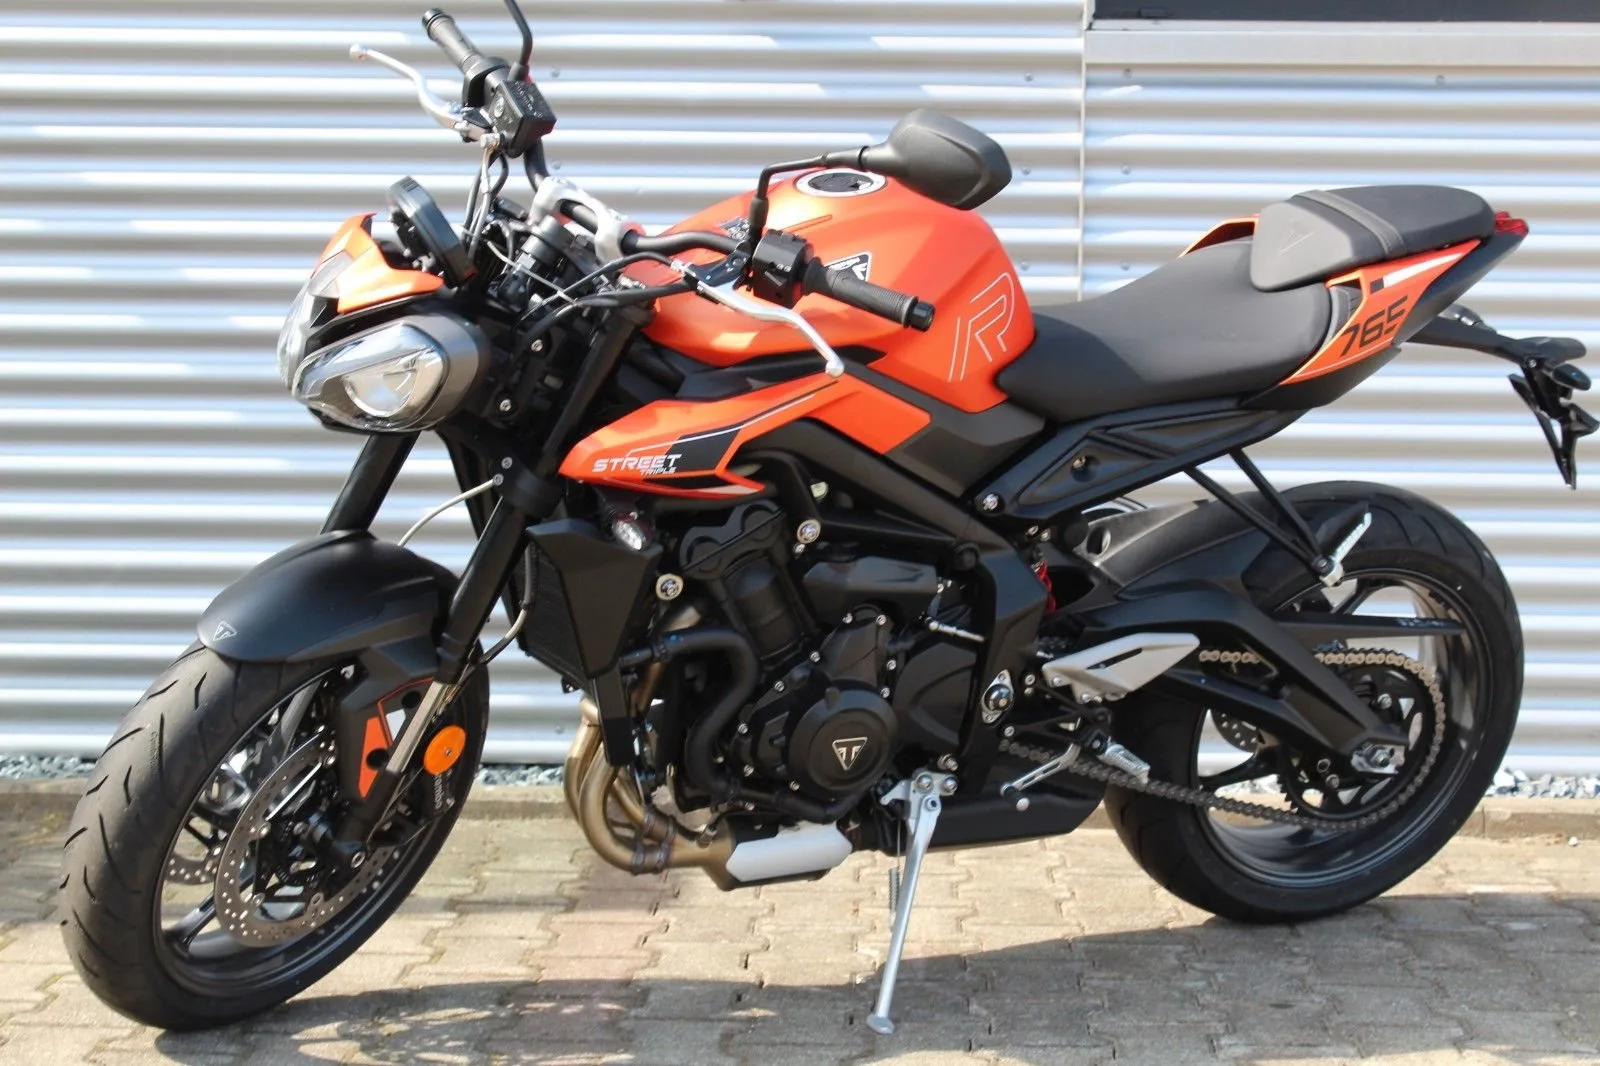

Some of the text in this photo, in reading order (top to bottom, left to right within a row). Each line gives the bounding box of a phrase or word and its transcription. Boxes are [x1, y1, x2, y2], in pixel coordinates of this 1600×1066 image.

[1341, 295, 1408, 357] 765
[592, 454, 682, 472] STREET
[640, 466, 677, 476] TRIPLE
